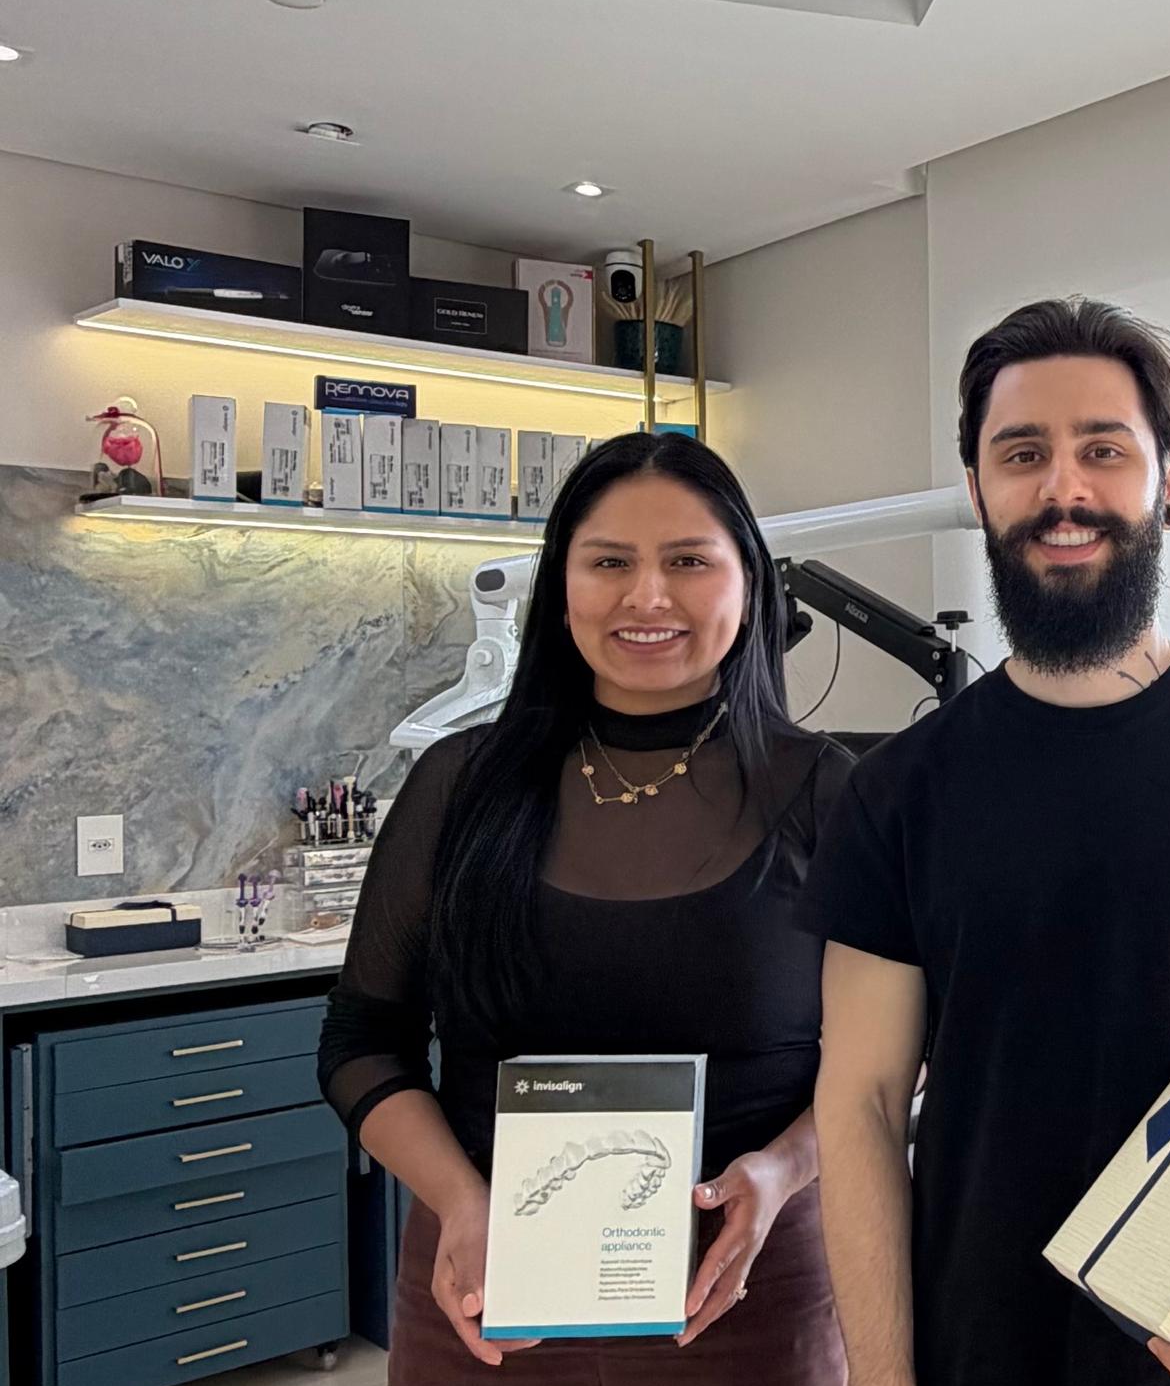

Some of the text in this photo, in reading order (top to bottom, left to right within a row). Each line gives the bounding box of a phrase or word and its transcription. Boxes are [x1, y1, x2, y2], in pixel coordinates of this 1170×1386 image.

[142, 251, 184, 269] VALO
[532, 1080, 583, 1094] invisalign
[602, 1227, 666, 1238] Orthodontic
[601, 1241, 653, 1253] appliance
